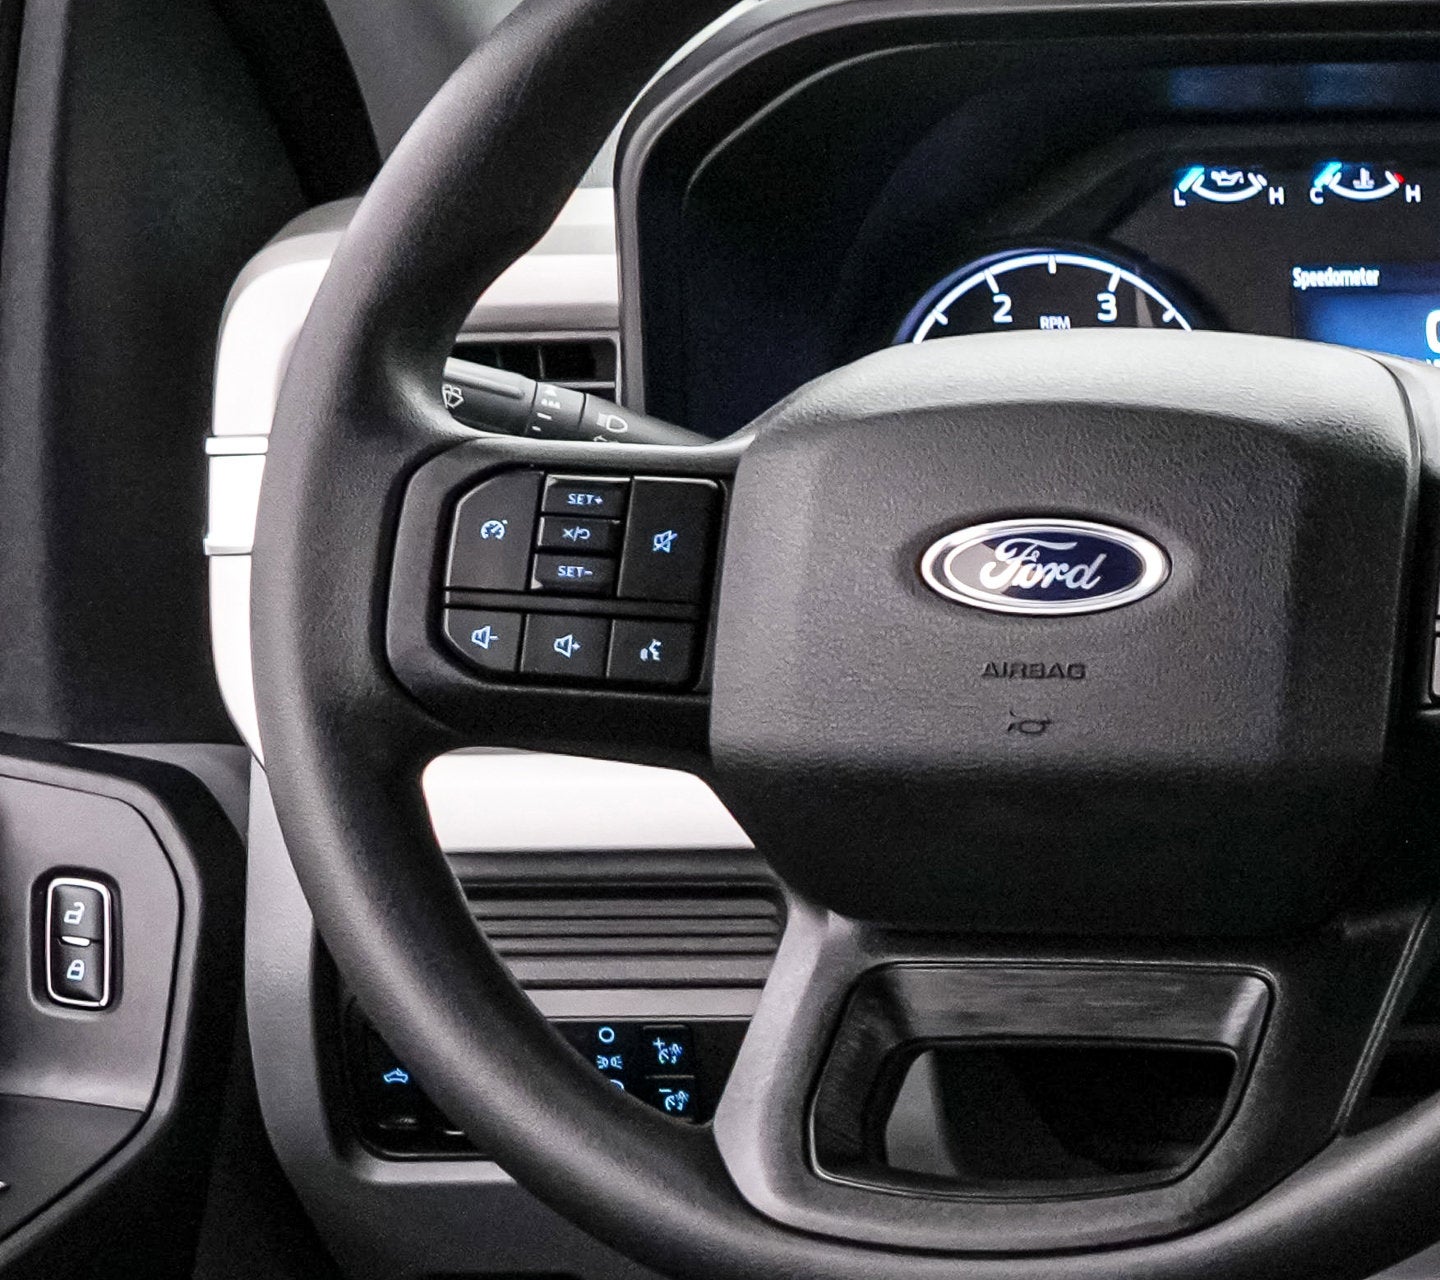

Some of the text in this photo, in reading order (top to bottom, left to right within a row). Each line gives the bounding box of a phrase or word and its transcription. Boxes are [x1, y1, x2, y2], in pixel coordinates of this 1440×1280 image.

[1173, 188, 1187, 207] L
[1268, 186, 1285, 206] H
[1309, 187, 1324, 205] C
[1404, 184, 1422, 204] H
[1292, 266, 1380, 290] Speedometer
[992, 293, 1014, 324] 2
[1096, 292, 1118, 322] 3
[1039, 315, 1071, 330] RPM
[979, 536, 1108, 590] Ford
[981, 661, 1087, 680] AIRBAG
